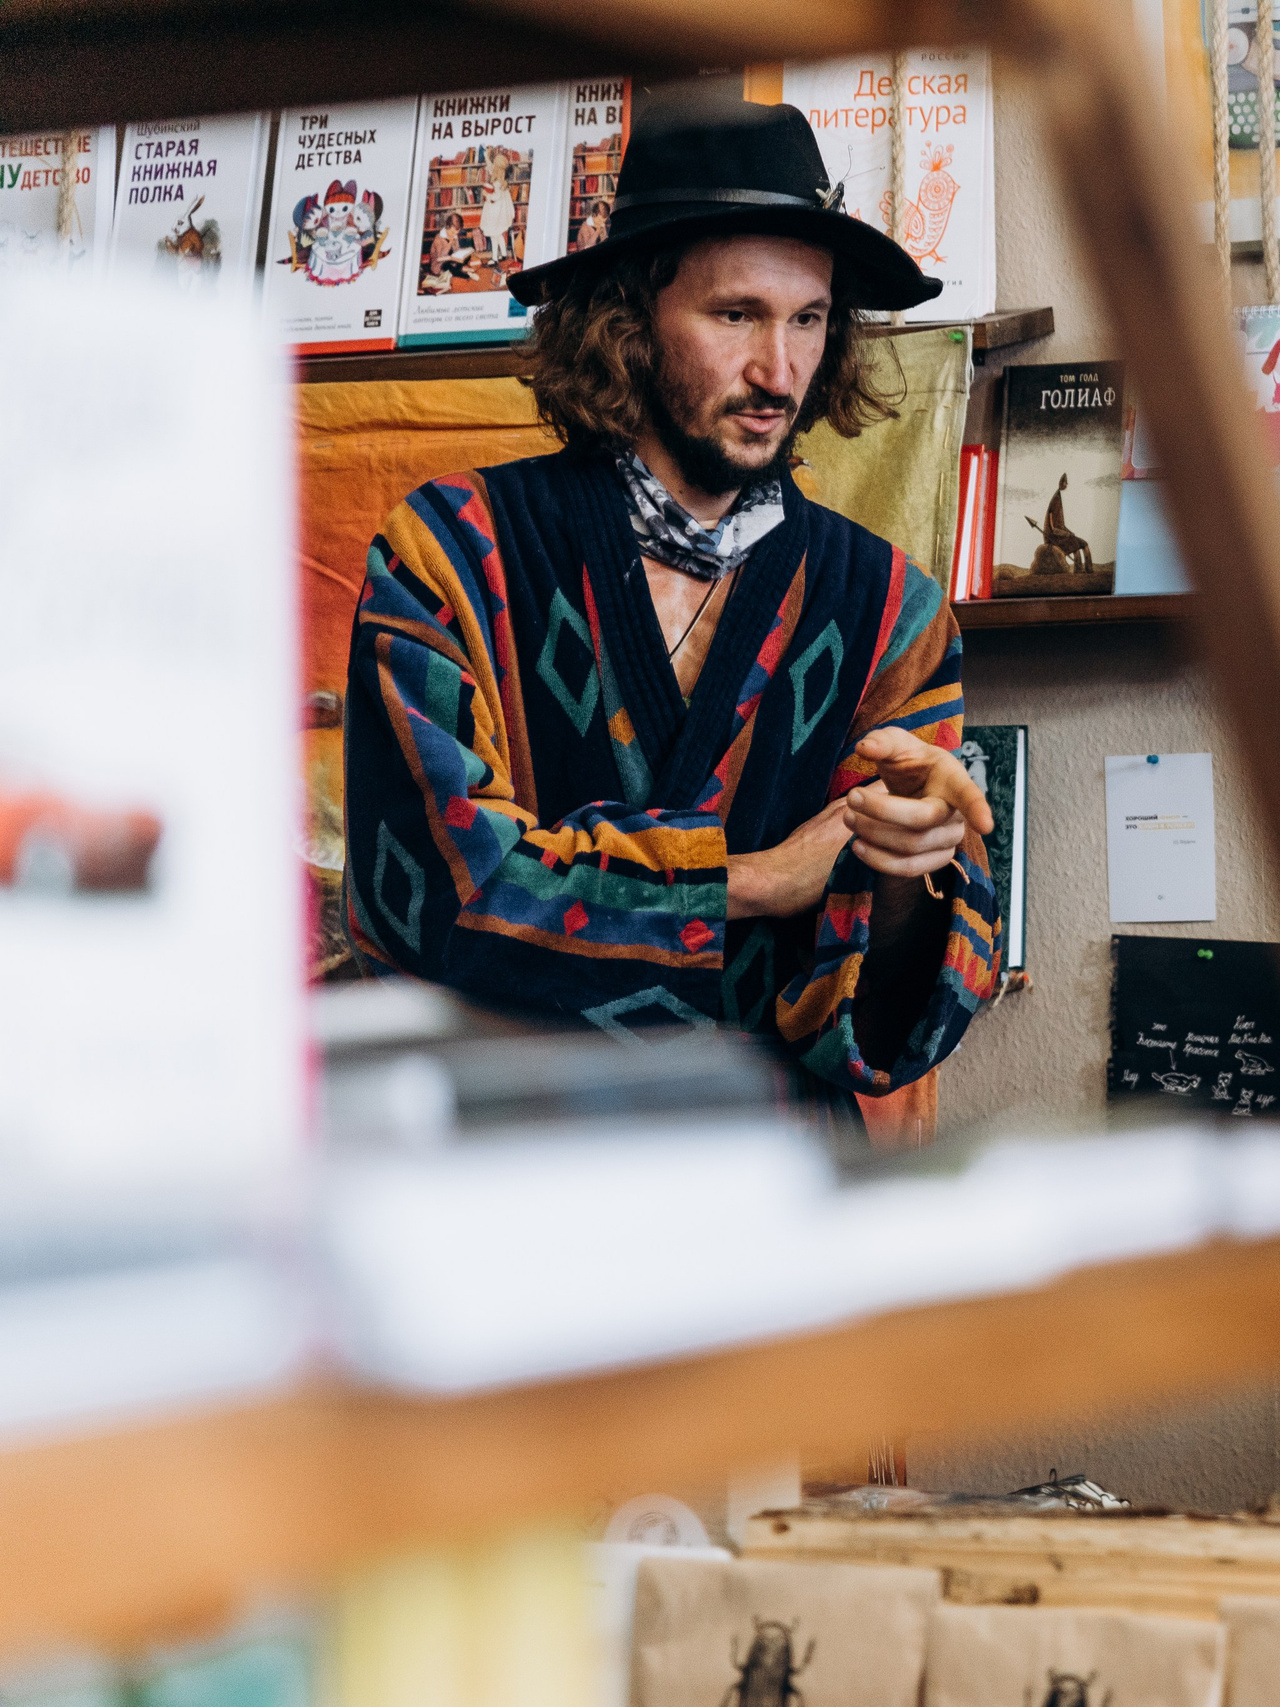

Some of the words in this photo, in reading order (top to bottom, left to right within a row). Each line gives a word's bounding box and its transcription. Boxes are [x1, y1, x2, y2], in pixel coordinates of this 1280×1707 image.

[854, 70, 968, 101] Деская
[433, 95, 511, 118] КНИЖКИ
[575, 107, 597, 126] НА
[137, 119, 200, 138] Шубинский
[300, 114, 329, 131] ТРИ
[431, 121, 454, 140] НА
[461, 115, 537, 138] ВЫРОСТ
[135, 139, 199, 160] СТАРАЯ
[298, 129, 377, 150] ЧУДЕСНЫХ
[295, 149, 362, 170] ДЕТСТВА
[131, 160, 217, 183] КНИЖНАЯ
[129, 184, 184, 205] ПОЛКА
[1080, 373, 1099, 382] ГОЛД
[1040, 387, 1116, 409] ГОЛИАФ
